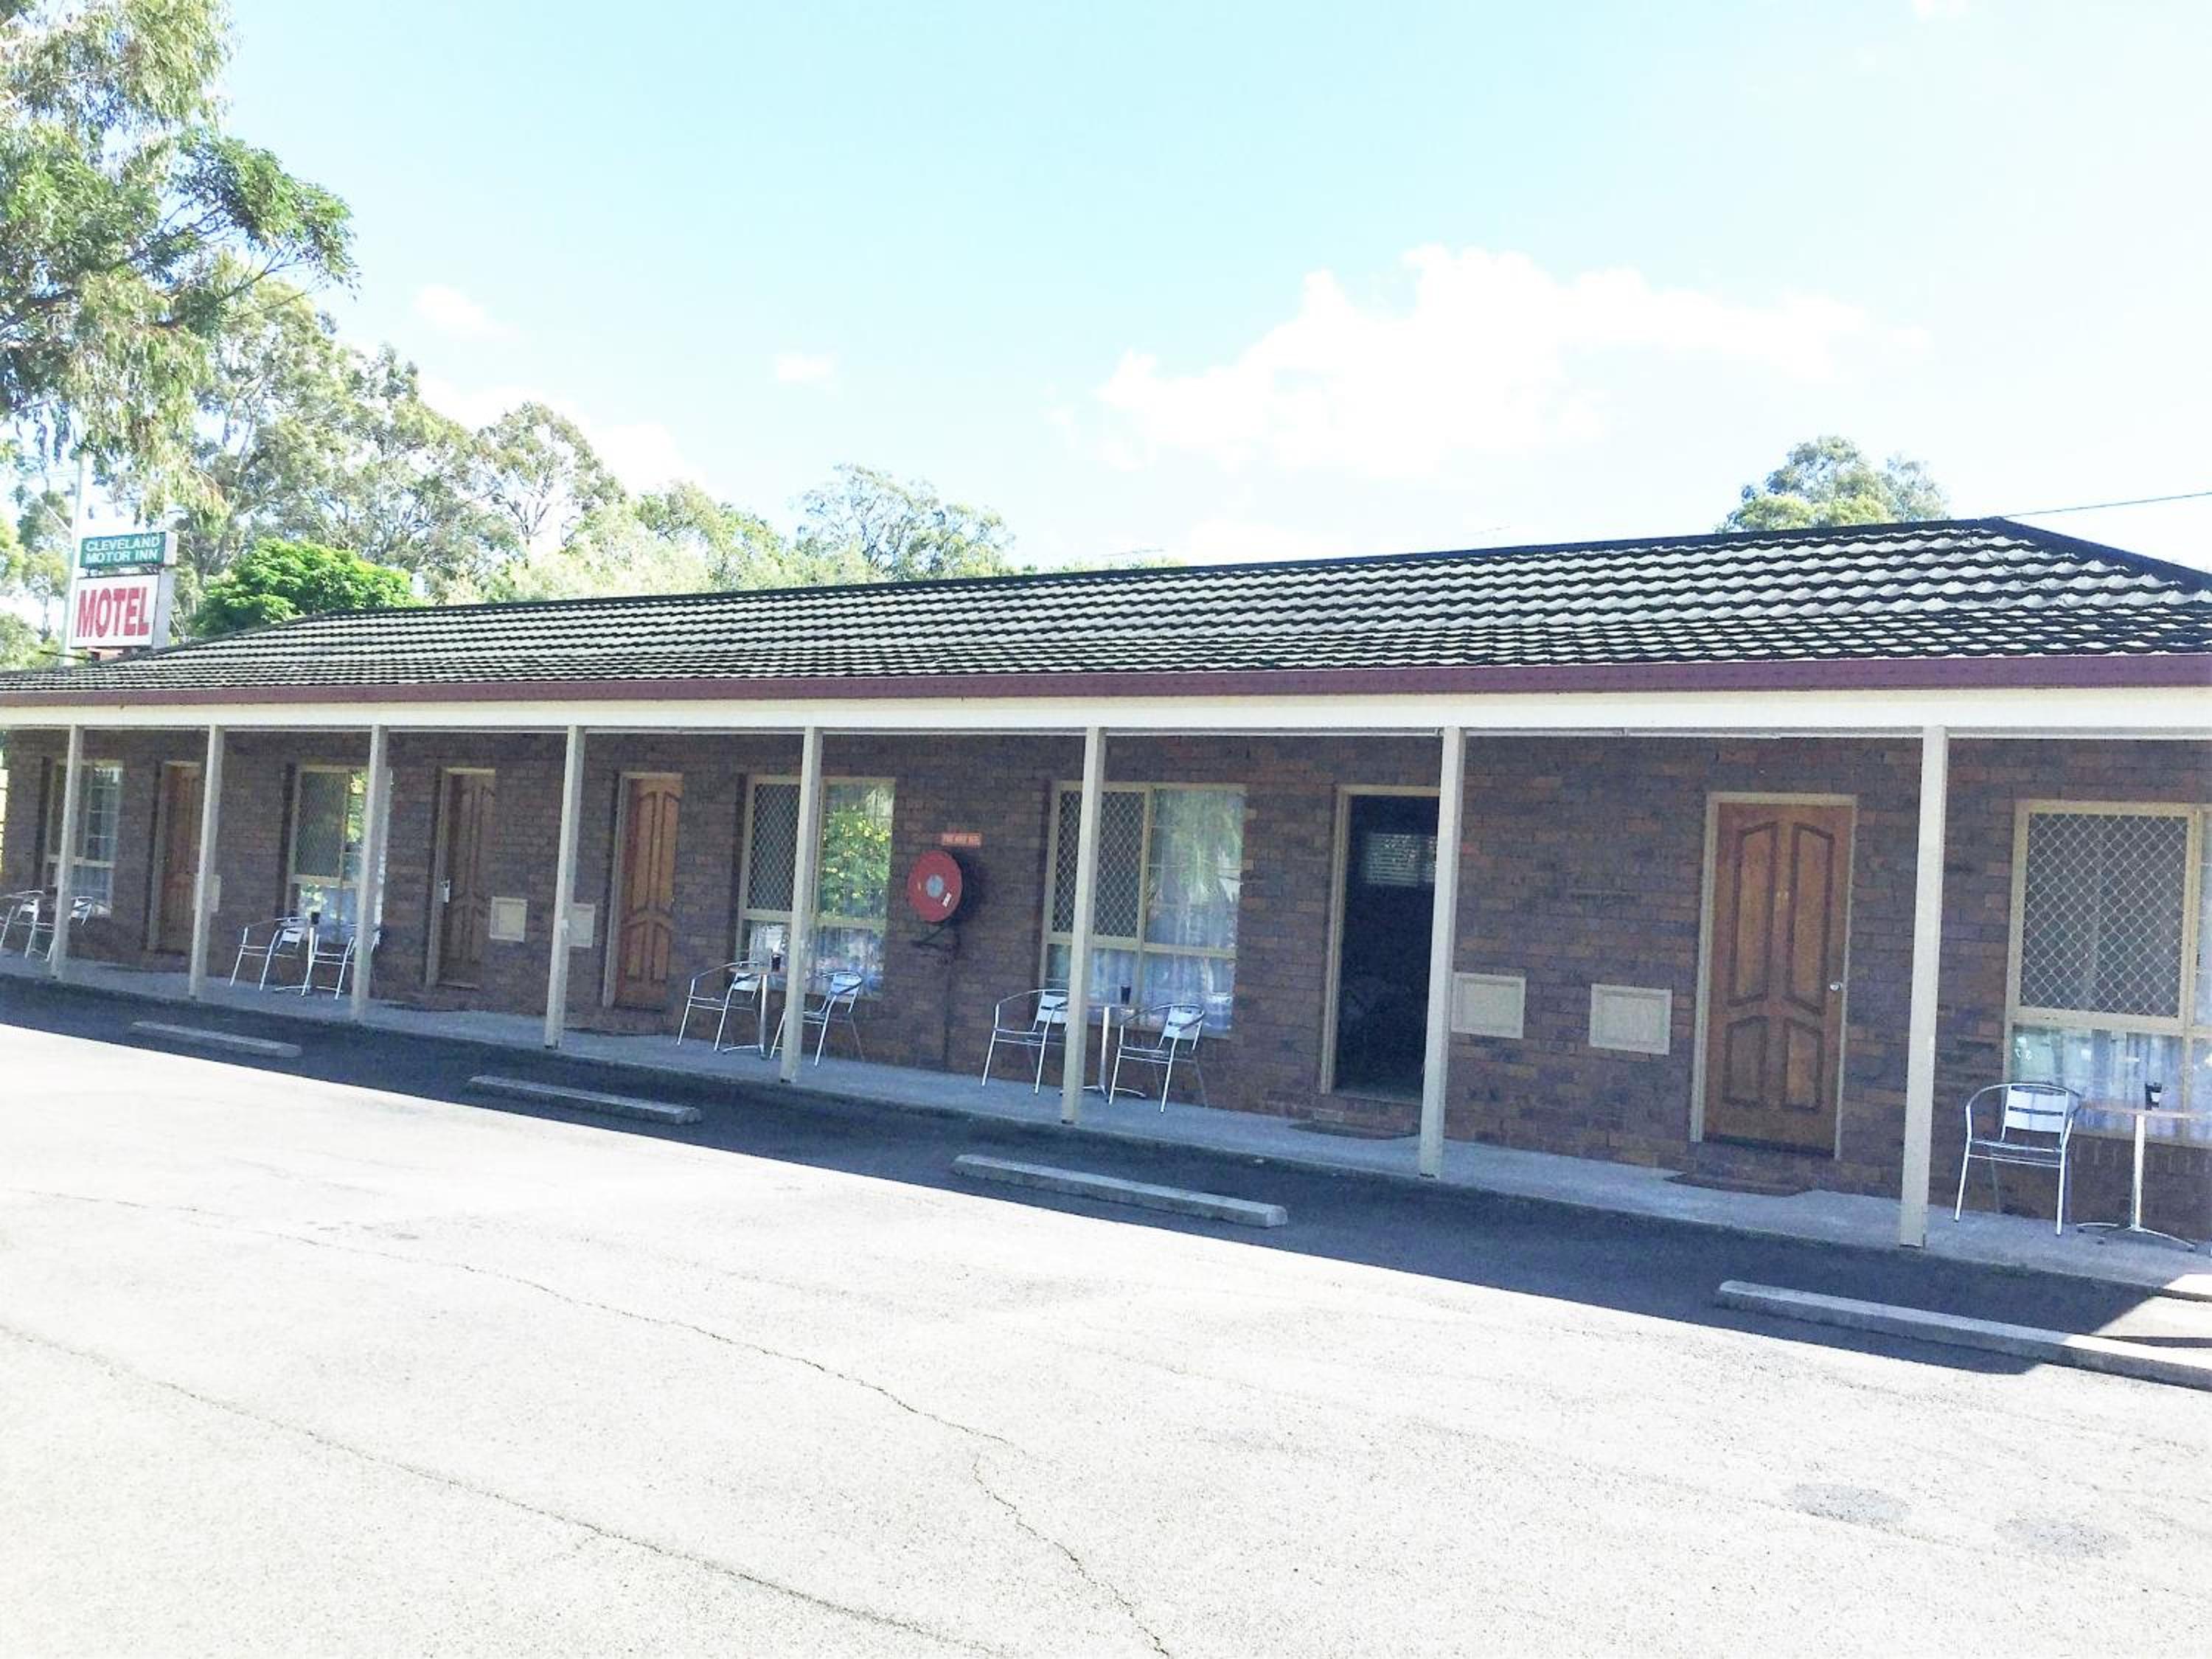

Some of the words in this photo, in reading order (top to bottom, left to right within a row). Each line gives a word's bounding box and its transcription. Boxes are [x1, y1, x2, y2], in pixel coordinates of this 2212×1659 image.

[86, 536, 159, 552] CLEVELAND
[86, 552, 131, 563] MOTOR
[135, 549, 158, 561] INN
[76, 587, 150, 638] MOTEL
